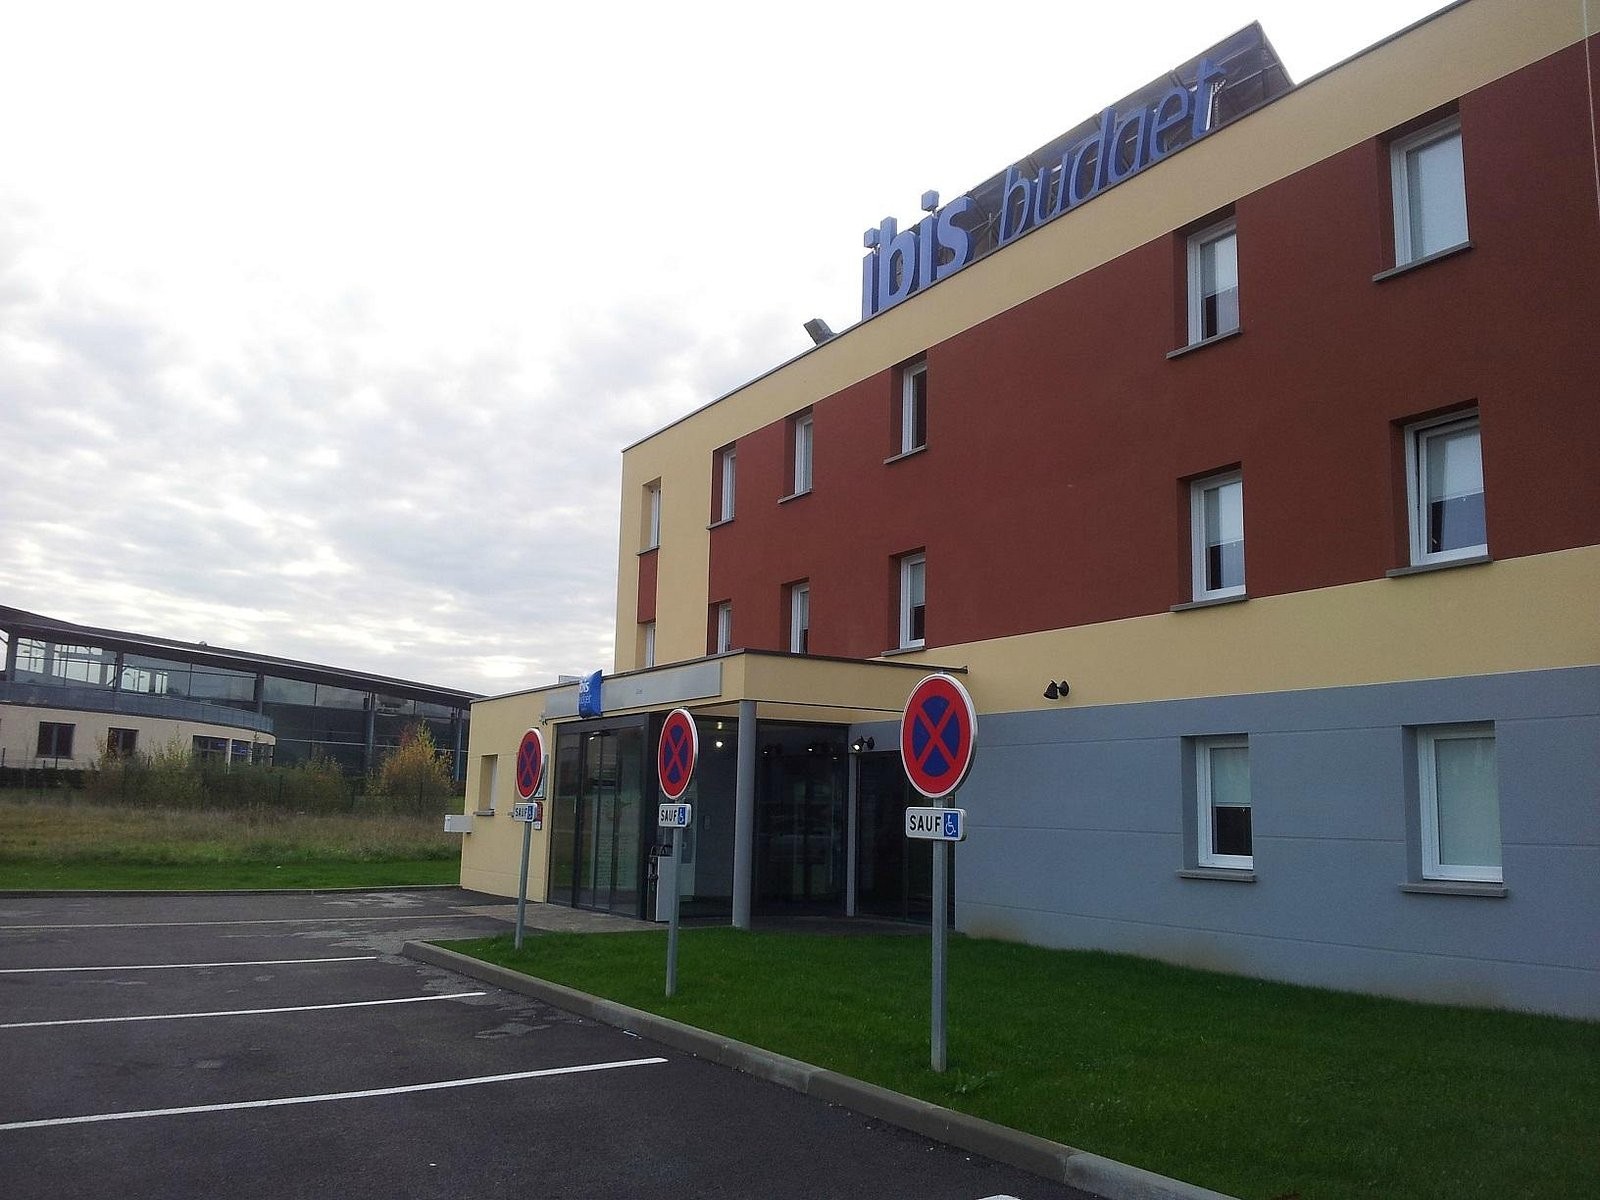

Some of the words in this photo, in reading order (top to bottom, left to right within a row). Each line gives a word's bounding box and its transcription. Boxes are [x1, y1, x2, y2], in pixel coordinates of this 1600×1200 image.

[862, 189, 972, 321] ibis
[661, 809, 678, 822] SAUF
[909, 815, 941, 832] SAUF
